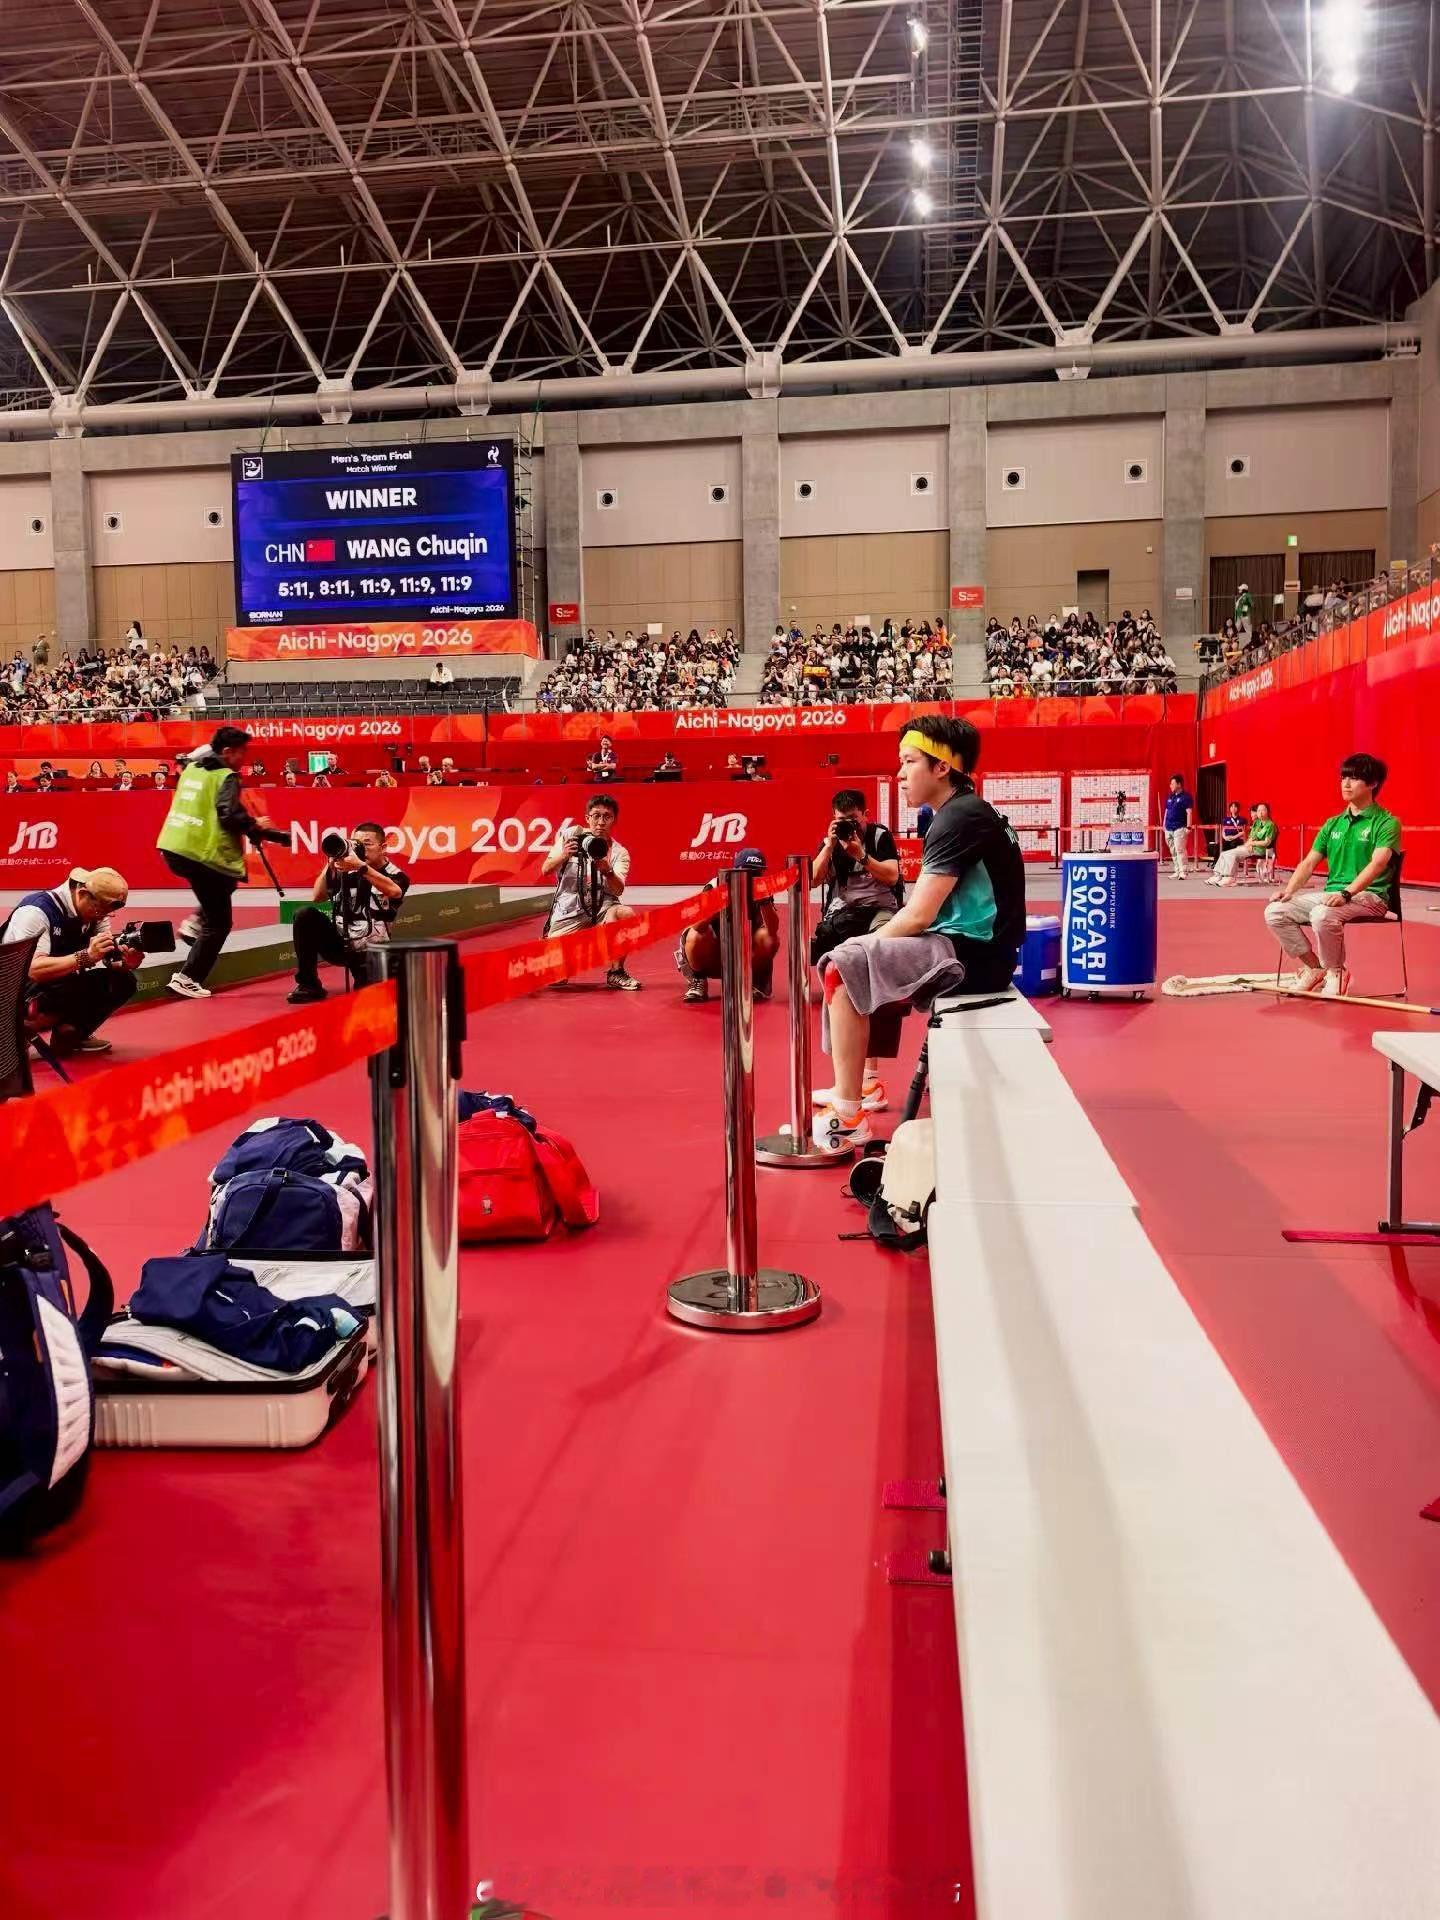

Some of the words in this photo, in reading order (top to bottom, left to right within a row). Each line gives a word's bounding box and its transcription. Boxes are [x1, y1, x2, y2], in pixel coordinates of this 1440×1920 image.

[331, 454, 359, 464] Men's
[361, 453, 387, 462] Team
[389, 450, 412, 460] Final
[346, 465, 370, 473] Match
[371, 464, 398, 472] Winner
[325, 487, 418, 510] WINNER
[265, 542, 305, 563] CHN
[346, 537, 411, 559] WANG
[416, 532, 488, 561] Chuqin
[278, 581, 315, 599] 5:11,
[319, 579, 355, 598] 8:11,
[360, 578, 396, 596] 11:9,
[400, 577, 436, 595] 11:9,
[440, 575, 473, 592] 11:9
[485, 604, 505, 612] 2026
[277, 630, 416, 652] Aichi-Nagoya
[421, 628, 473, 646] 2026
[244, 721, 355, 741] Aichi-Nagoya
[360, 721, 401, 735] 2026
[675, 712, 796, 732] Aichi-Nagoya
[801, 710, 846, 727] 2026
[8, 821, 58, 855] JTB
[690, 812, 748, 848] JTB
[1072, 865, 1088, 970] SWEAT
[1088, 866, 1108, 981] POCARI
[138, 1046, 275, 1121] Aichi-Nagoya
[277, 1027, 318, 1067] 2026
